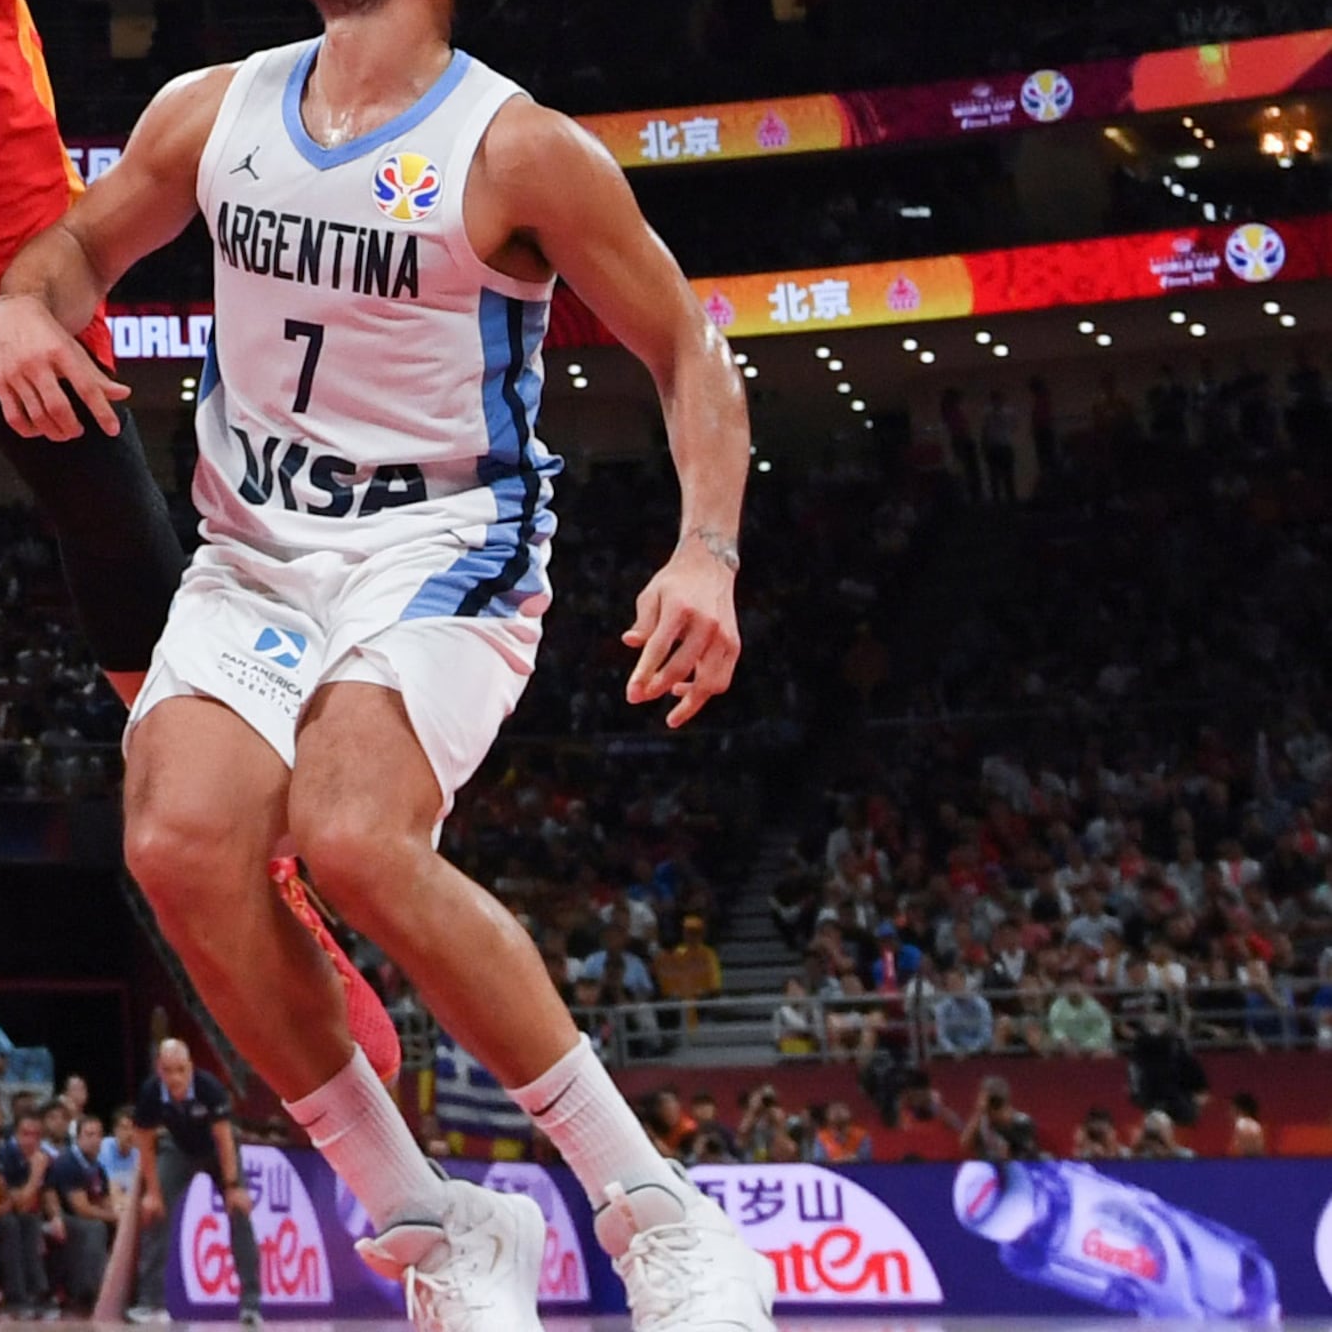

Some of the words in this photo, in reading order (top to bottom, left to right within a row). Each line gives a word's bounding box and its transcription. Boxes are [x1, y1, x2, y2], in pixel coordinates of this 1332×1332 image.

[638, 115, 722, 162] 北京
[217, 201, 419, 299] ARGENTINA
[105, 315, 213, 358] ORLD
[766, 277, 853, 325] 北京
[284, 318, 325, 414] 7
[229, 424, 428, 518] VISA
